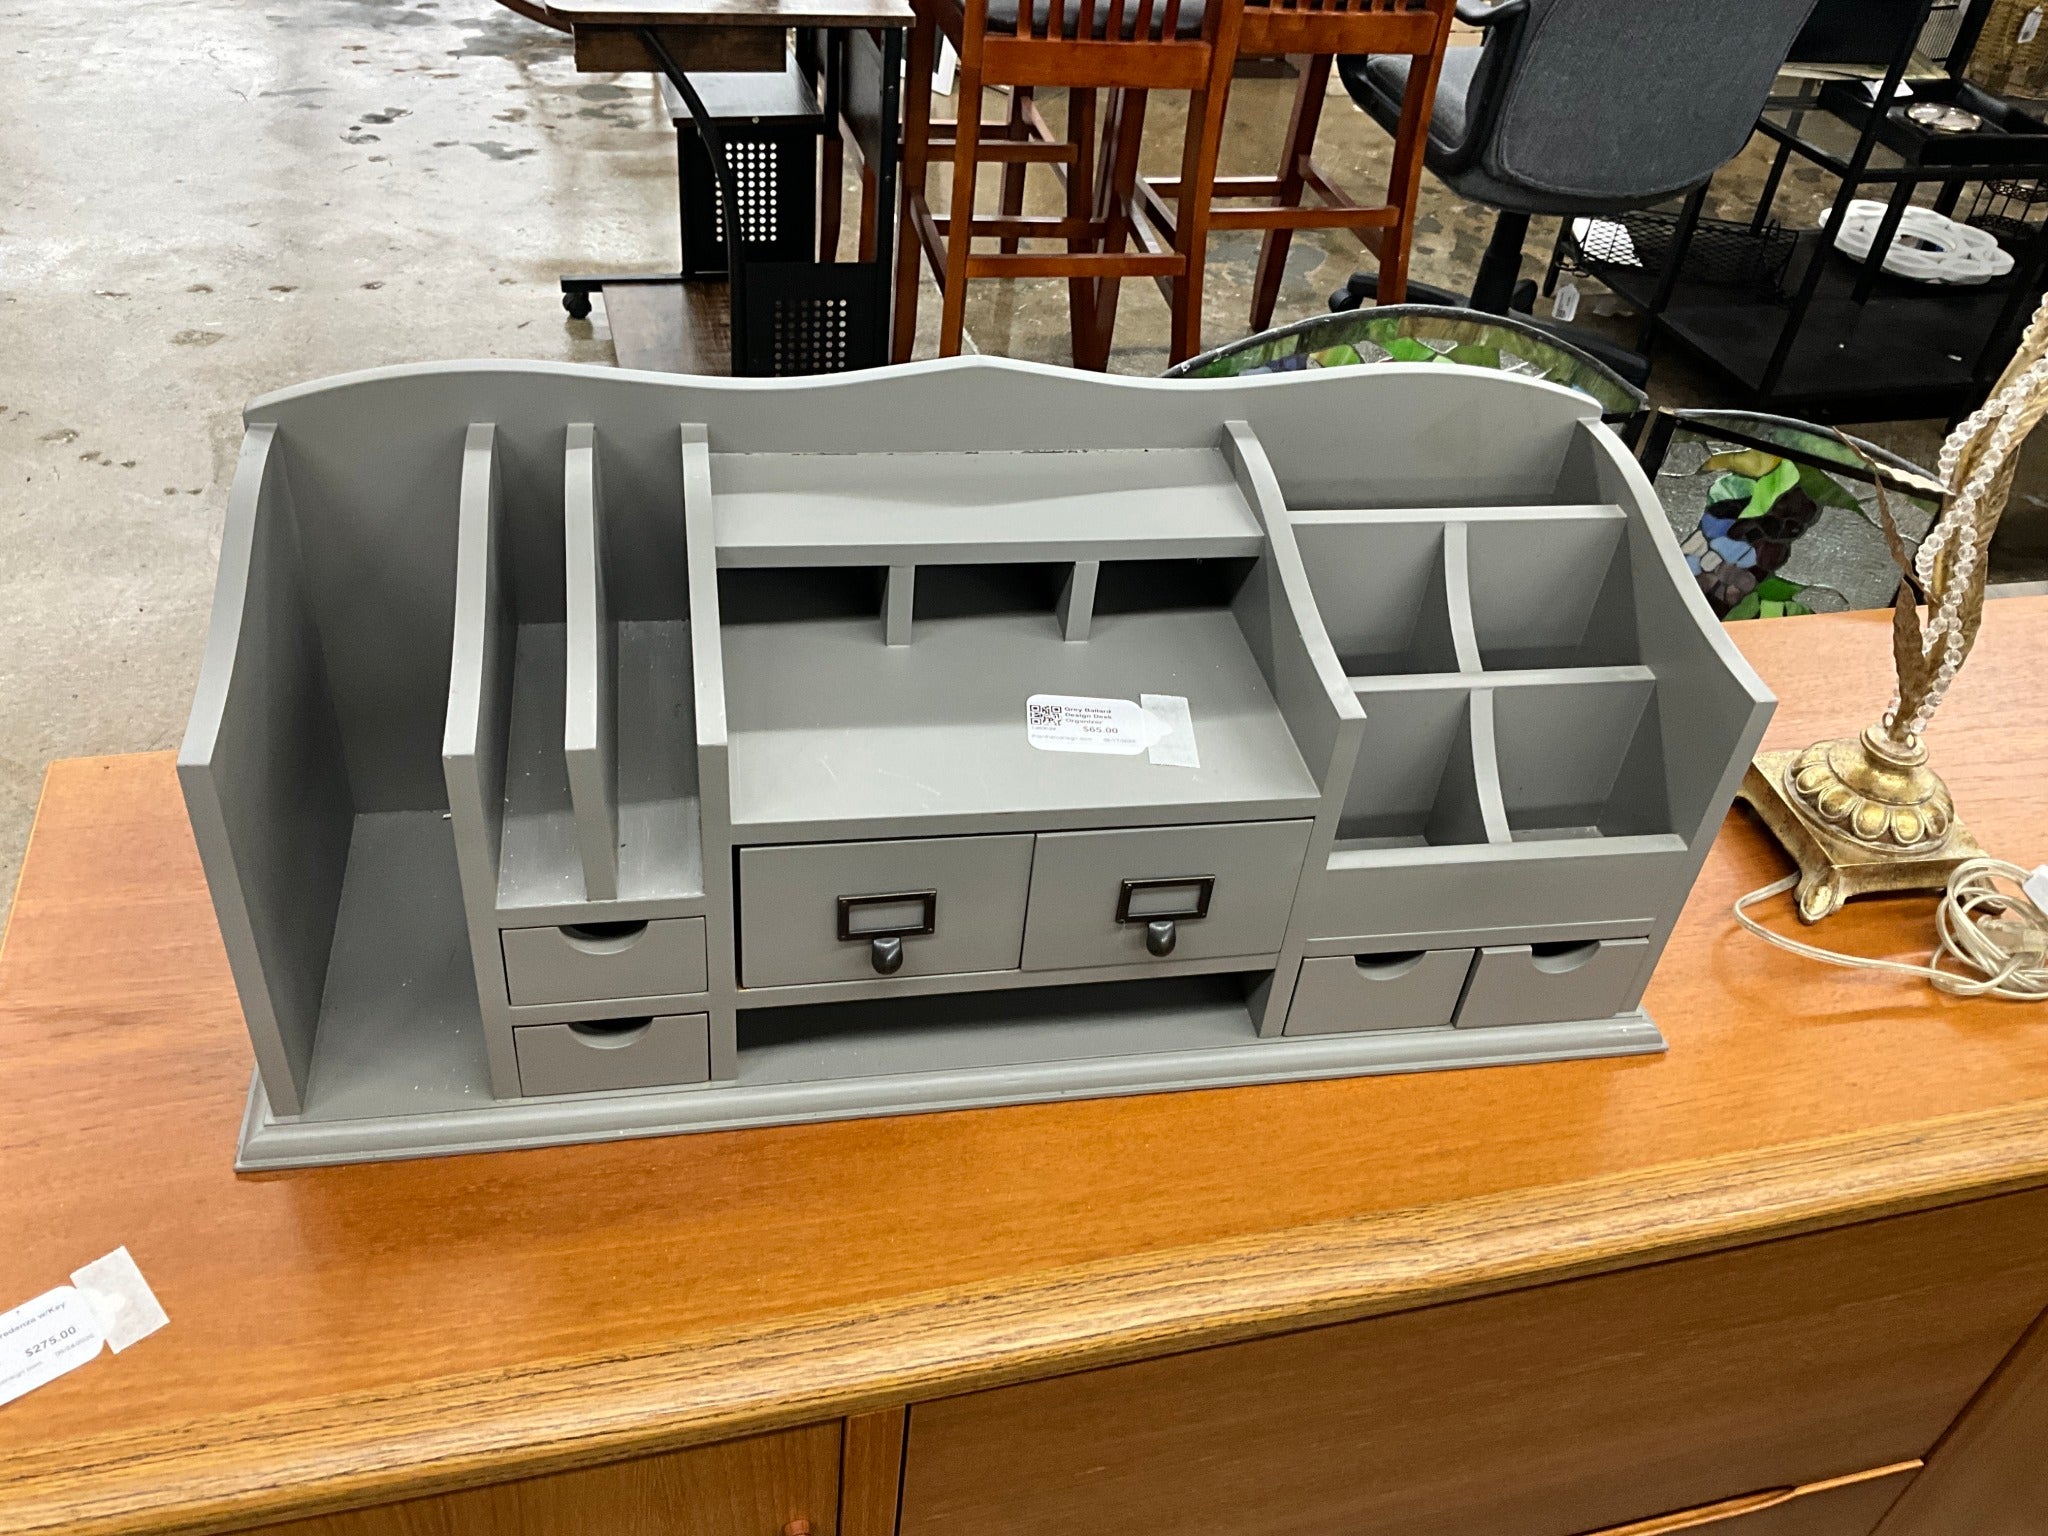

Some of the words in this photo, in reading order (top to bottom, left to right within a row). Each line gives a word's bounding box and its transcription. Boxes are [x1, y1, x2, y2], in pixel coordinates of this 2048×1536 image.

[1064, 706, 1082, 714] Grey
[1082, 725, 1118, 734] $65.00
[0, 1317, 37, 1339] redenza
[24, 1325, 77, 1358] $275.00
